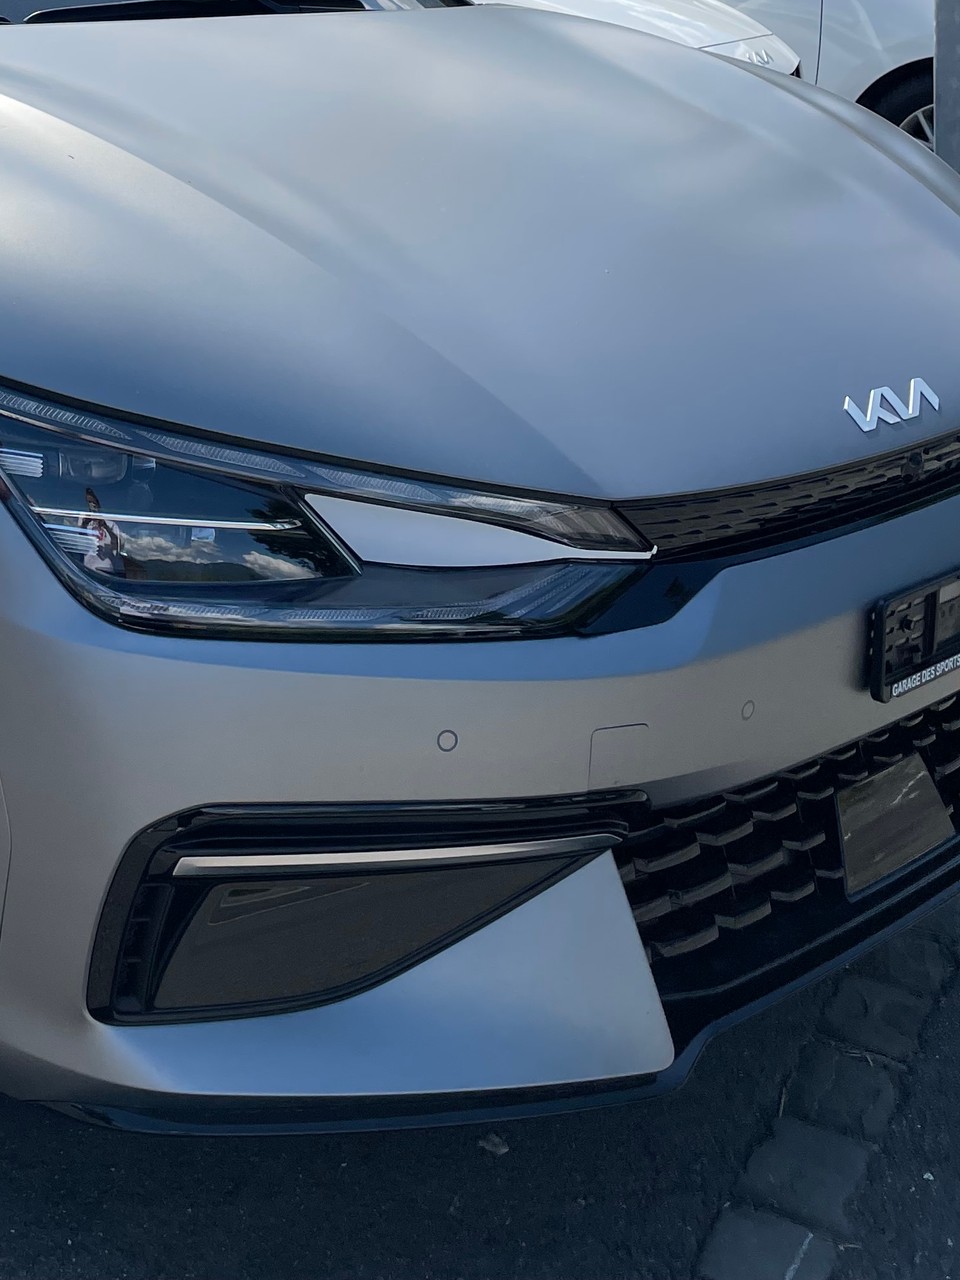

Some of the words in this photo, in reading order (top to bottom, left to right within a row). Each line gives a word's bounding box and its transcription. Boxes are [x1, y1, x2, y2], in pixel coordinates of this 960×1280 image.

[892, 672, 921, 696] GARAGE
[921, 666, 936, 683] DES
[936, 653, 960, 676] SPORTS
